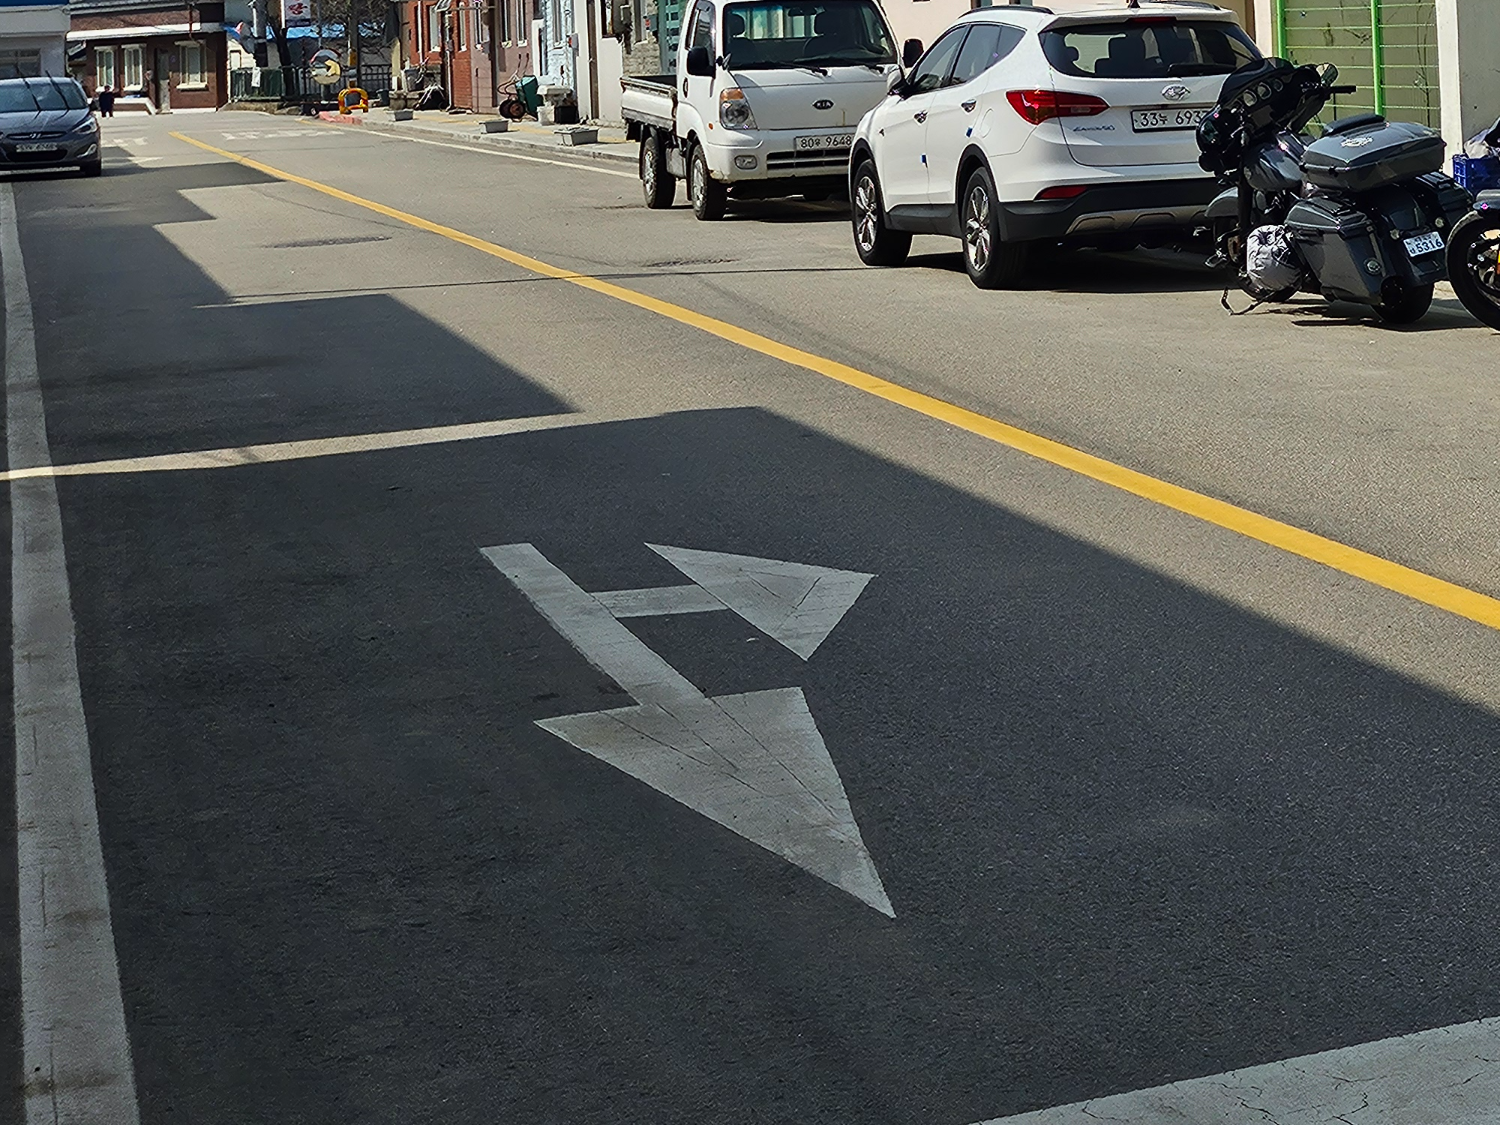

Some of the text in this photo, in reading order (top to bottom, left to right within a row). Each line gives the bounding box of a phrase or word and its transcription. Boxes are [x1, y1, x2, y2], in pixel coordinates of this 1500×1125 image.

[1175, 109, 1208, 125] 693
[825, 135, 852, 147] 9648
[1415, 238, 1443, 253] 5316
